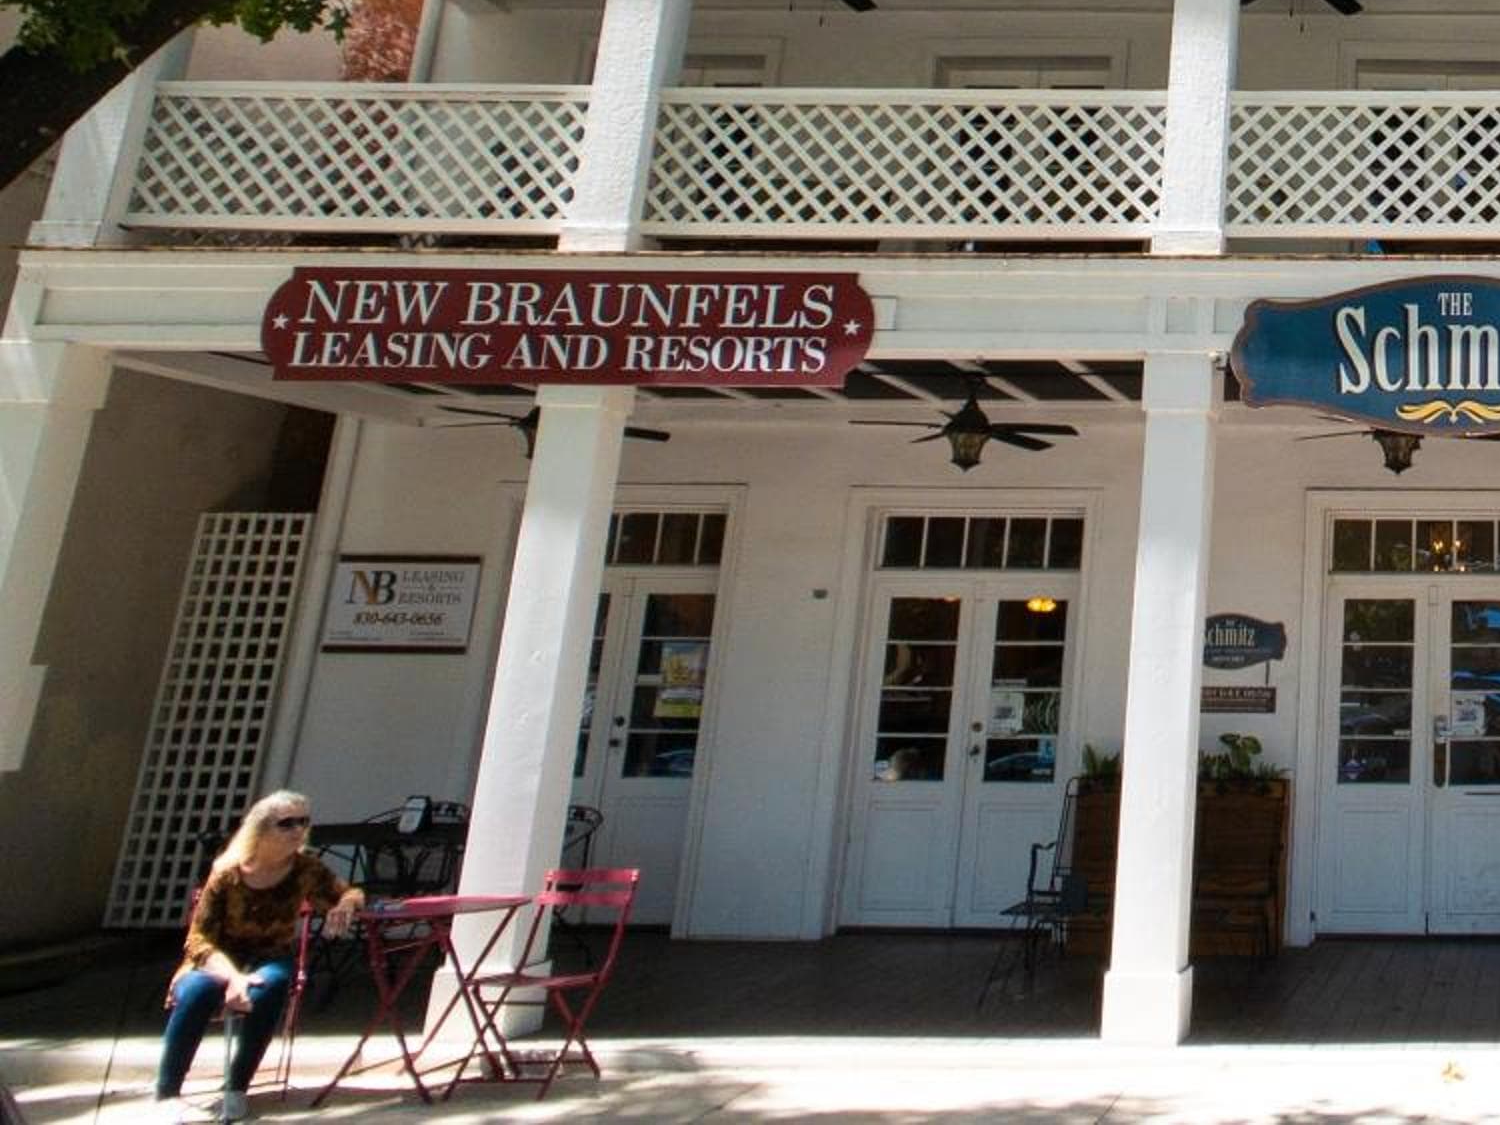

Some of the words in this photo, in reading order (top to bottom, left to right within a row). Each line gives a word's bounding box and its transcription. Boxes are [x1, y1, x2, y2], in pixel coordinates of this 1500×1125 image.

[300, 279, 446, 325] NEW
[461, 281, 834, 330] BRAUNFELS
[1438, 292, 1473, 316] THE
[287, 332, 492, 370] LEASING
[503, 333, 608, 371] AND
[623, 335, 828, 375] RESORTS
[345, 570, 397, 605] NB
